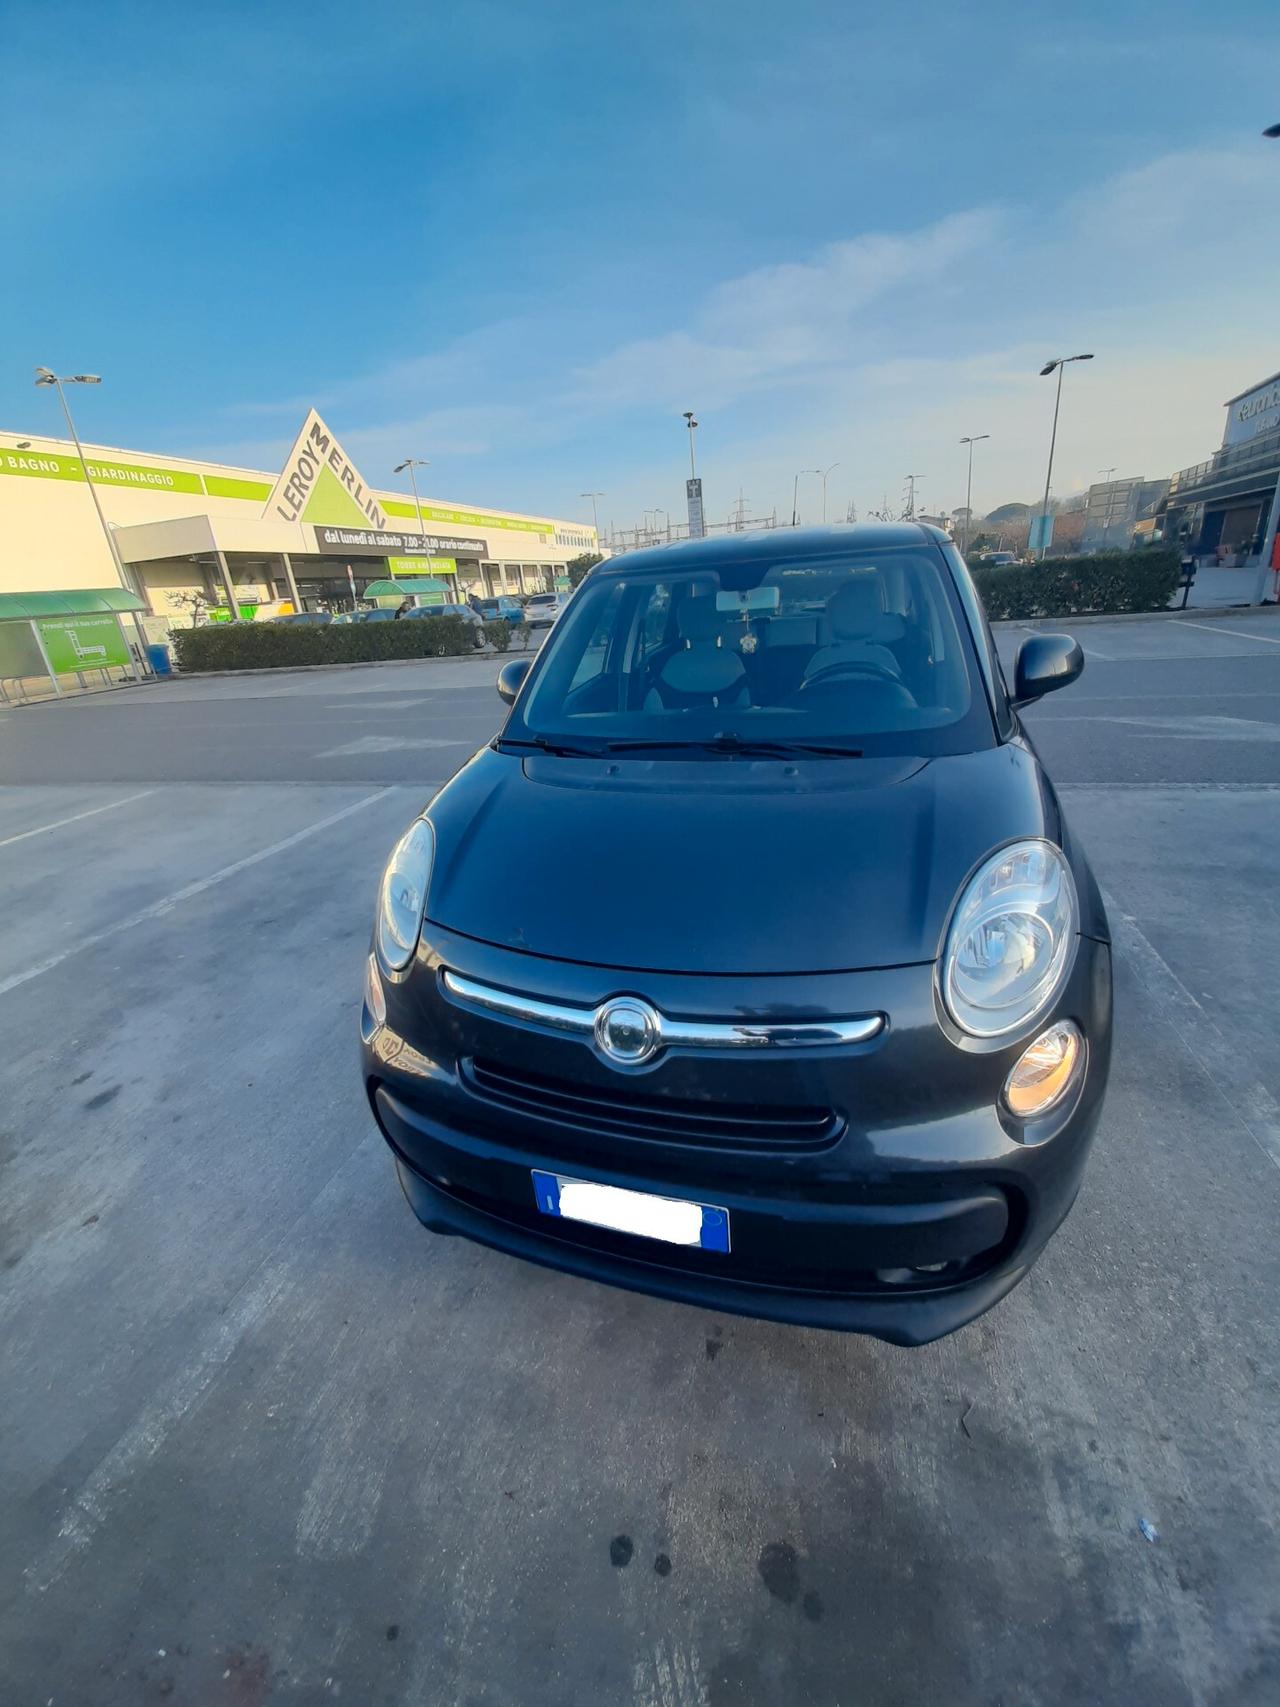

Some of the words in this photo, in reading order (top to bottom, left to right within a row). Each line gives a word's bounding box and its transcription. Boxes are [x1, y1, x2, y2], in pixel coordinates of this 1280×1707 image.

[7, 456, 60, 473] BAGNO
[87, 465, 175, 486] GIARDINAGGIO
[277, 440, 320, 521] LEROY
[310, 422, 386, 529] MERLIN
[325, 529, 340, 543] dal
[340, 530, 367, 545] lunedì
[368, 532, 376, 545] al
[376, 534, 402, 546] sabato
[403, 536, 418, 548] 7.00
[439, 540, 457, 550] orario
